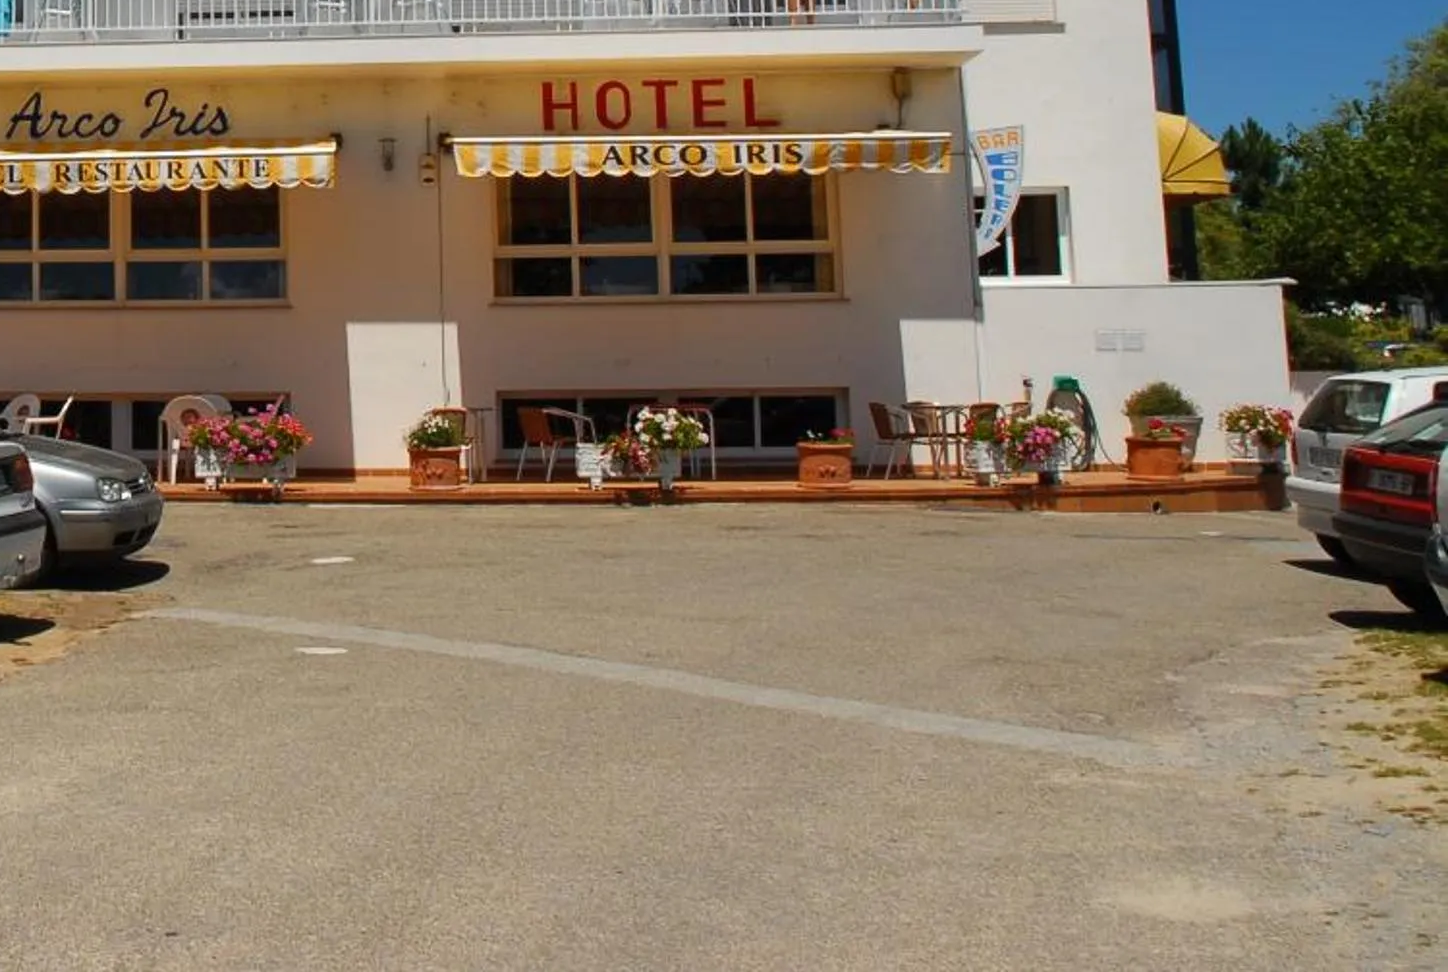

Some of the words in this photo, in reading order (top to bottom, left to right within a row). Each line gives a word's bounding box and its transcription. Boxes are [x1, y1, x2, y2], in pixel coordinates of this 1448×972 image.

[6, 91, 124, 140] Arco
[140, 88, 231, 138] Iris
[541, 78, 782, 131] HOTEL
[55, 158, 271, 183] RESTAURANTE
[602, 144, 708, 166] ARCO
[733, 143, 804, 164] IRIS
